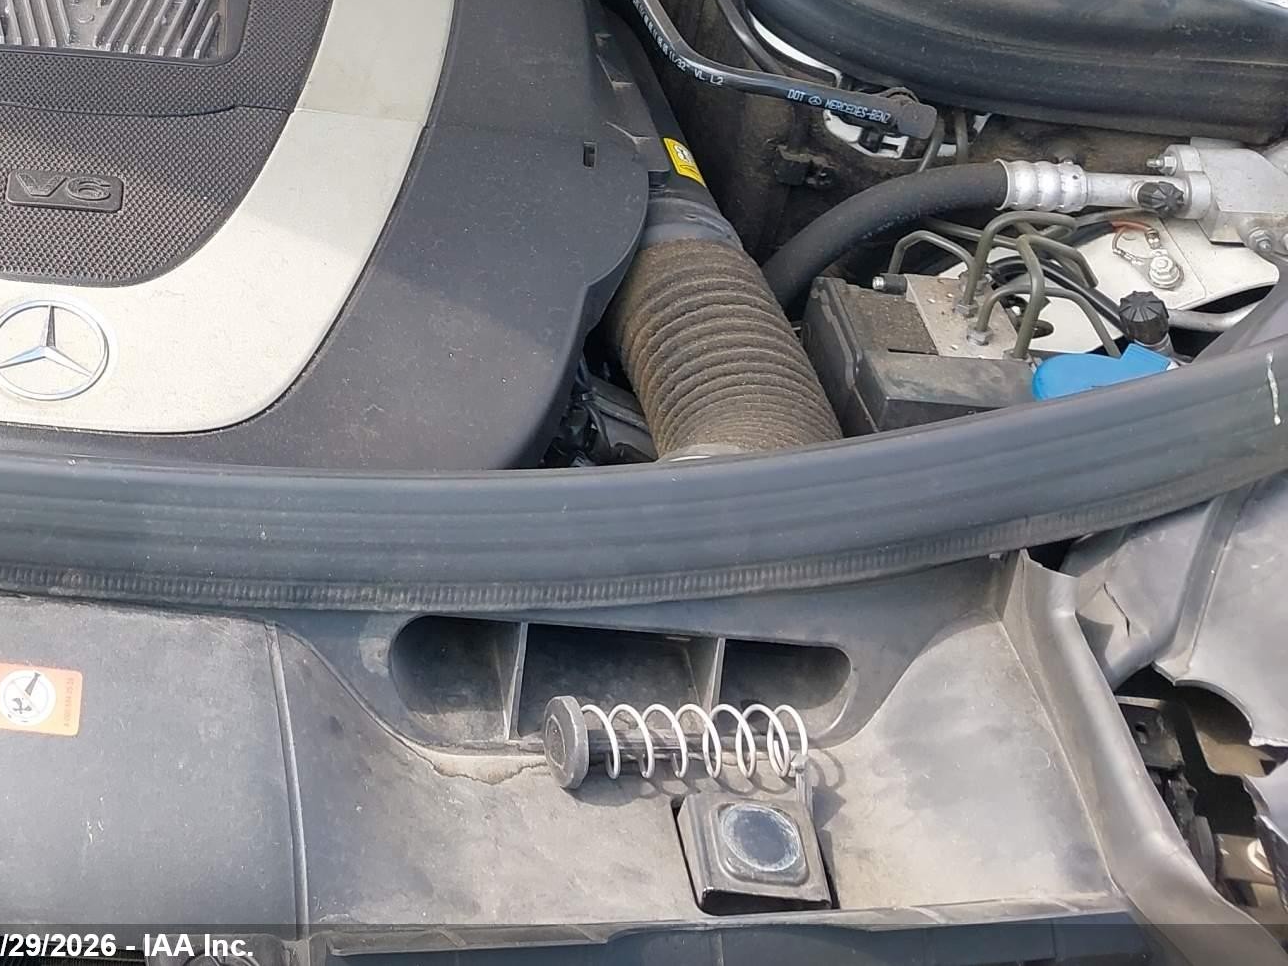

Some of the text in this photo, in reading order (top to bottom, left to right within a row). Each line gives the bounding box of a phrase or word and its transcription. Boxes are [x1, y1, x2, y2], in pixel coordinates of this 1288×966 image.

[709, 74, 724, 86] L2
[787, 89, 892, 124] DOT MERCEDES-BENZ
[15, 172, 111, 202] V6
